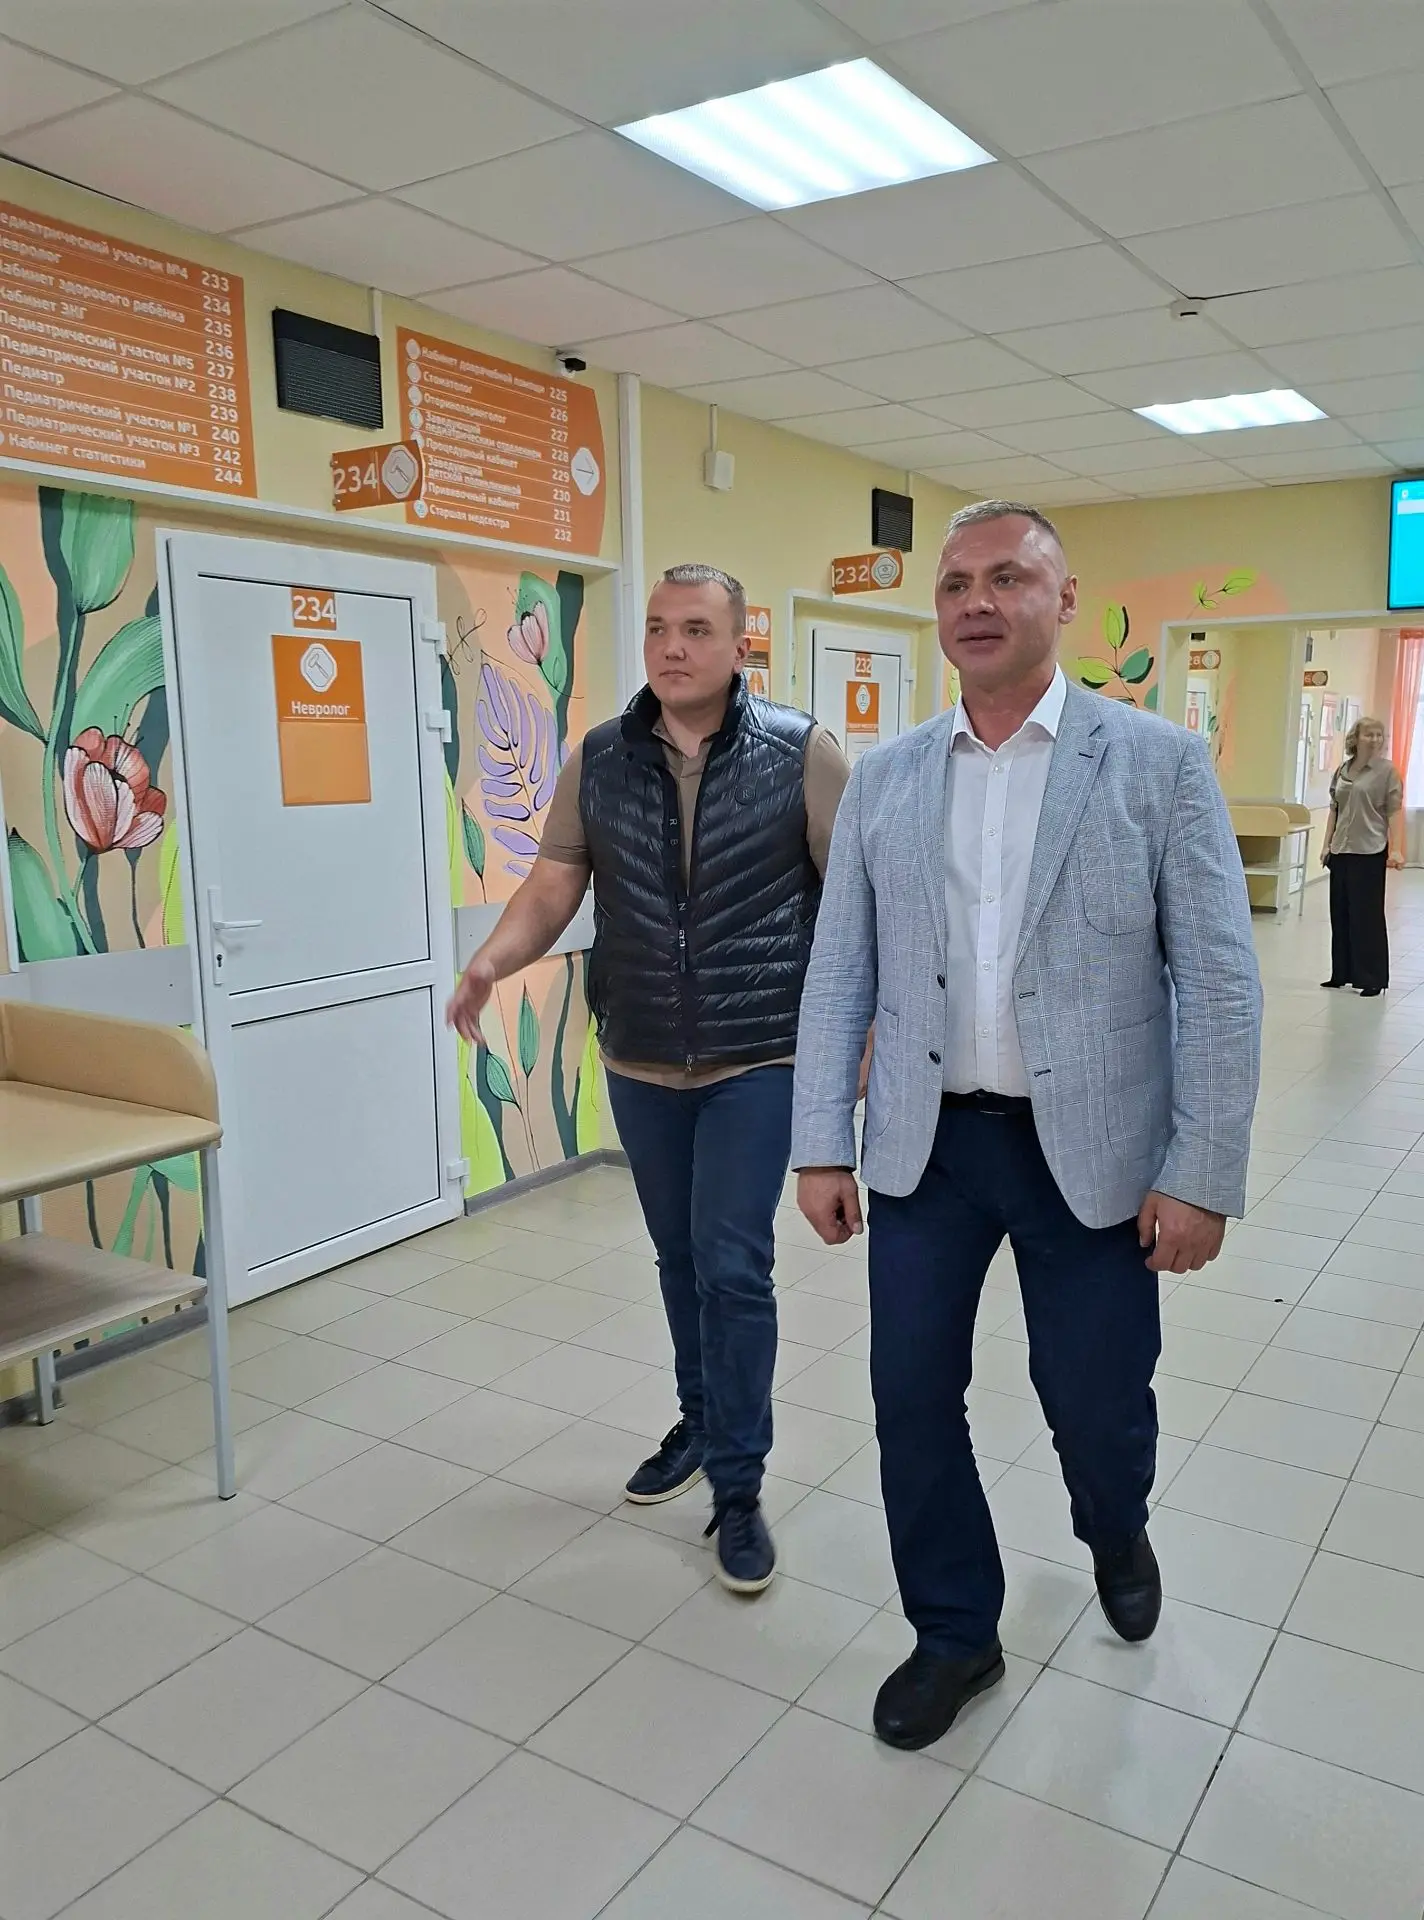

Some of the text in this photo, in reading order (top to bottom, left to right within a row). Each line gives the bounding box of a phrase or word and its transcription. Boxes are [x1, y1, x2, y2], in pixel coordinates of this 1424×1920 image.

[0, 212, 229, 292] едиатрический участок №4 233
[0, 236, 231, 315] евролог 234
[59, 279, 130, 307] здорового
[204, 318, 233, 338] 235
[0, 310, 235, 380] Педиатрический участок №5 237
[60, 302, 88, 320] ЭКГ
[205, 340, 234, 360] 236
[1, 335, 237, 403] Педиатрический участок №2 238
[2, 359, 239, 423] Педиатр 239
[550, 387, 568, 402] 225
[4, 384, 240, 445] Педиатрический участок №1 240
[551, 408, 568, 422] 226
[6, 408, 241, 466] Педиатрический участок №3 242
[551, 429, 568, 443] 227
[8, 433, 243, 486] Кабинет статистики 244
[552, 449, 569, 463] 228
[332, 463, 377, 494] 234
[552, 469, 570, 484] 229
[553, 489, 571, 503] 230
[430, 504, 572, 542] Старшая медсестра 232
[554, 509, 571, 523] 231
[835, 565, 869, 585] 232
[293, 595, 337, 623] 234
[856, 657, 872, 673] 232
[291, 700, 350, 719] Невролог
